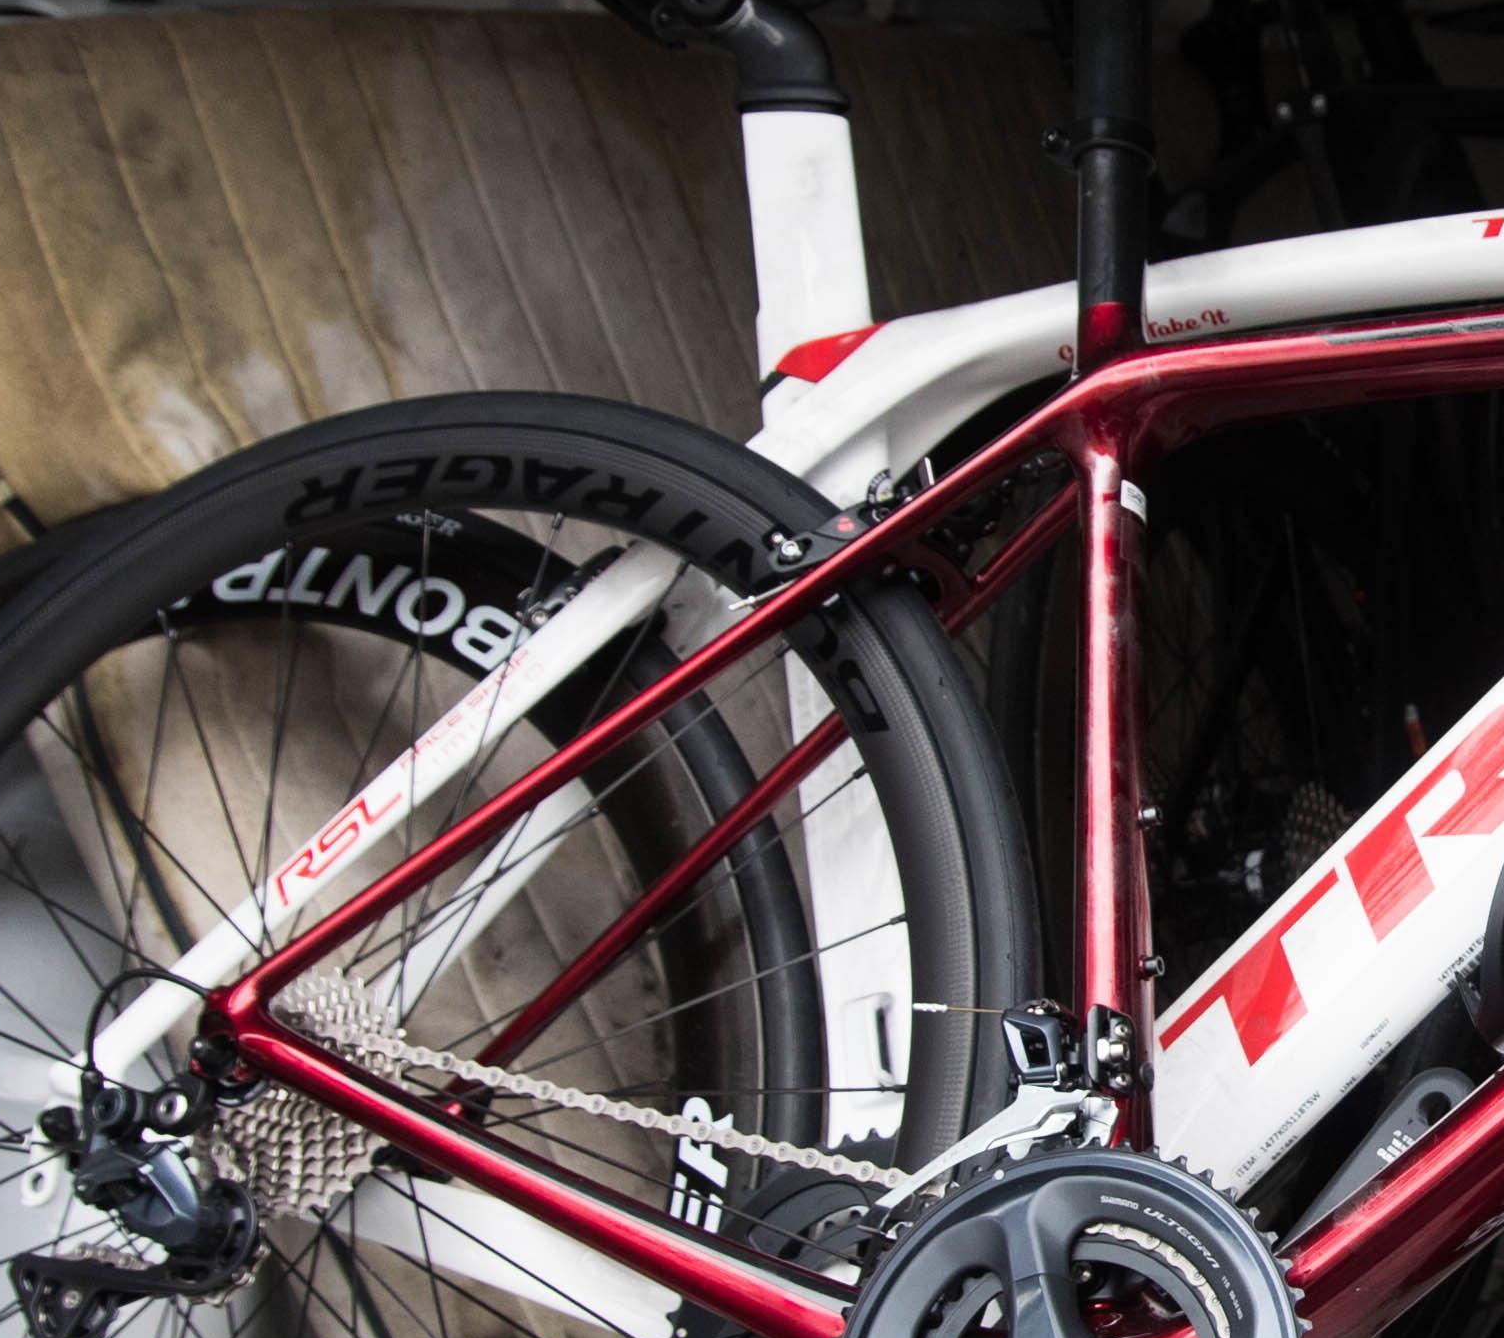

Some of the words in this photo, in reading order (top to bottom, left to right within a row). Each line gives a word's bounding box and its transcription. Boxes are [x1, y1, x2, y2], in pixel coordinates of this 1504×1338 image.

[209, 549, 530, 672] BONTR
[272, 778, 403, 908] RSL
[1143, 1207, 1221, 1269] ULTEGRA
